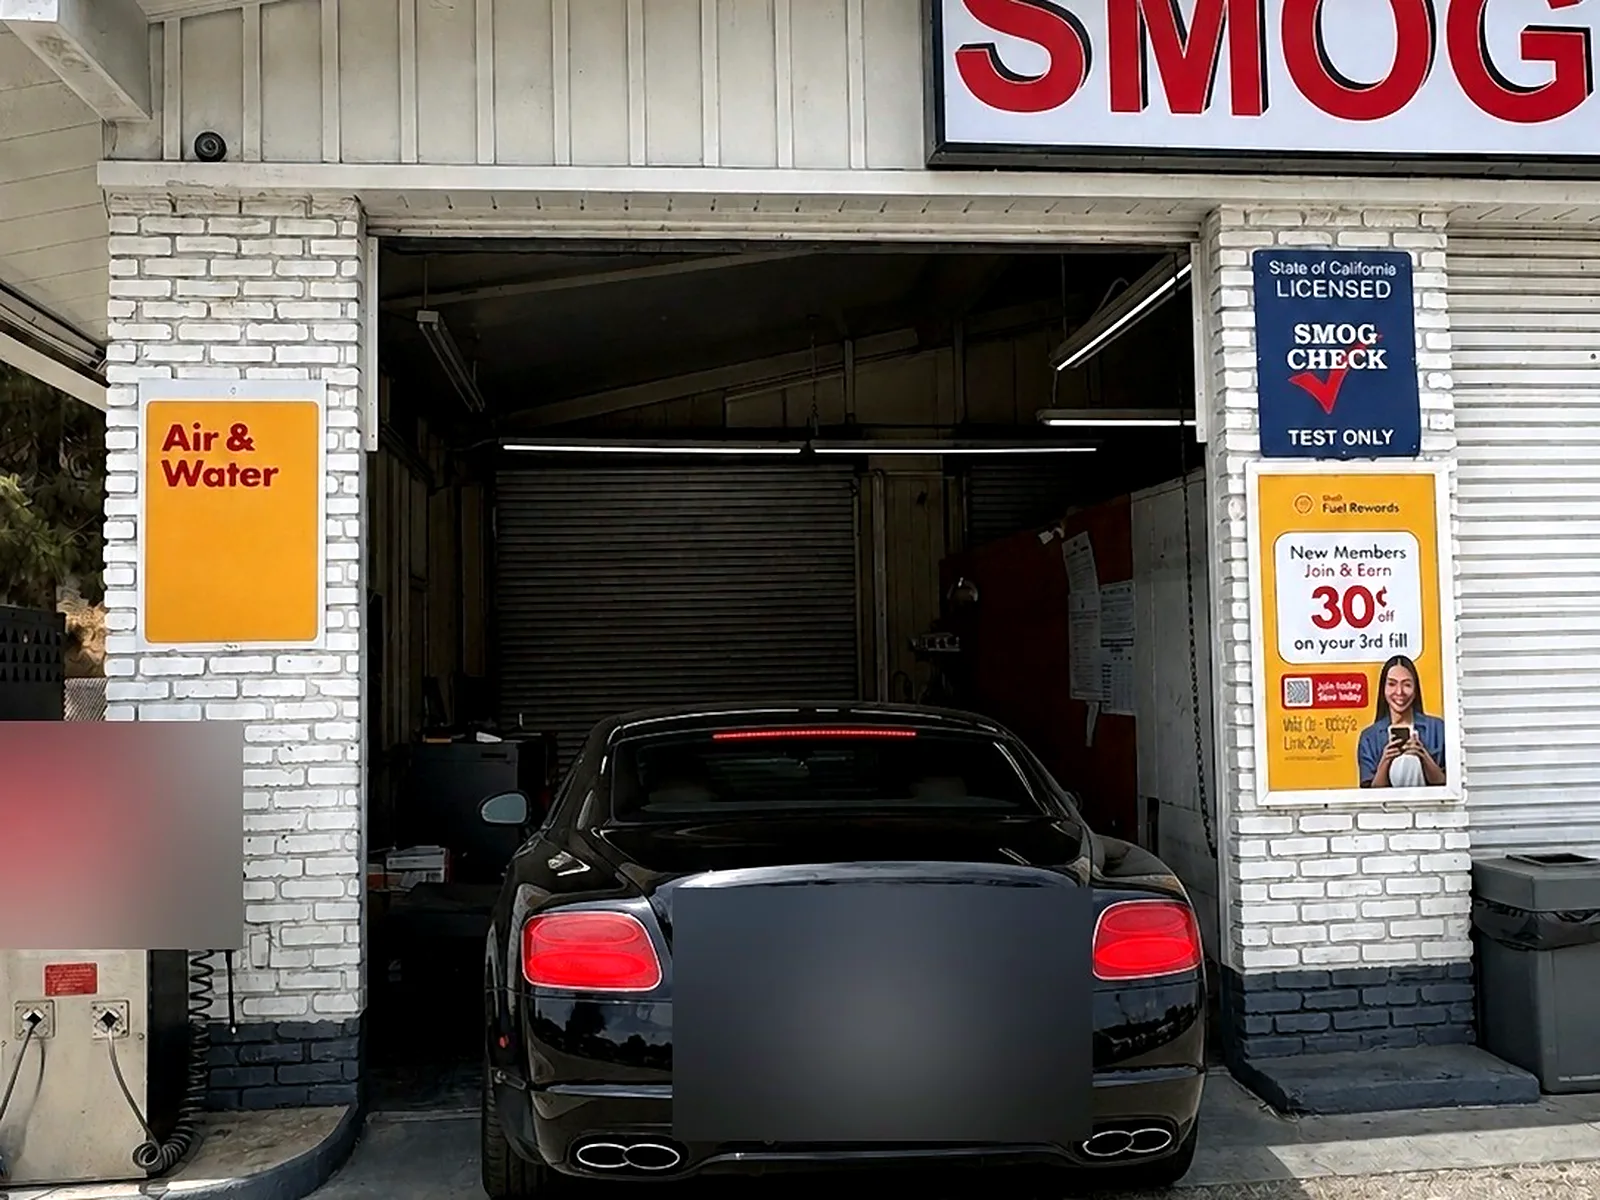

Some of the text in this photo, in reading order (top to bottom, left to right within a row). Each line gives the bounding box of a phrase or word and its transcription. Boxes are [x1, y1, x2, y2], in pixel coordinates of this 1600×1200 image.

[955, 0, 1594, 123] SMOG
[1269, 260, 1396, 276] State of California
[1276, 279, 1391, 298] LICENSED
[1294, 323, 1377, 344] SMOG
[1287, 349, 1387, 369] CHECK
[162, 422, 255, 451] Air &
[1288, 429, 1394, 445] TEST ONLY
[161, 459, 279, 487] Water
[1322, 502, 1400, 513] Fuel Rewards
[1290, 543, 1406, 560] New Members
[1304, 563, 1392, 578] Join & Earn
[1378, 610, 1395, 623] off
[1294, 633, 1408, 655] on your 3rd fill
